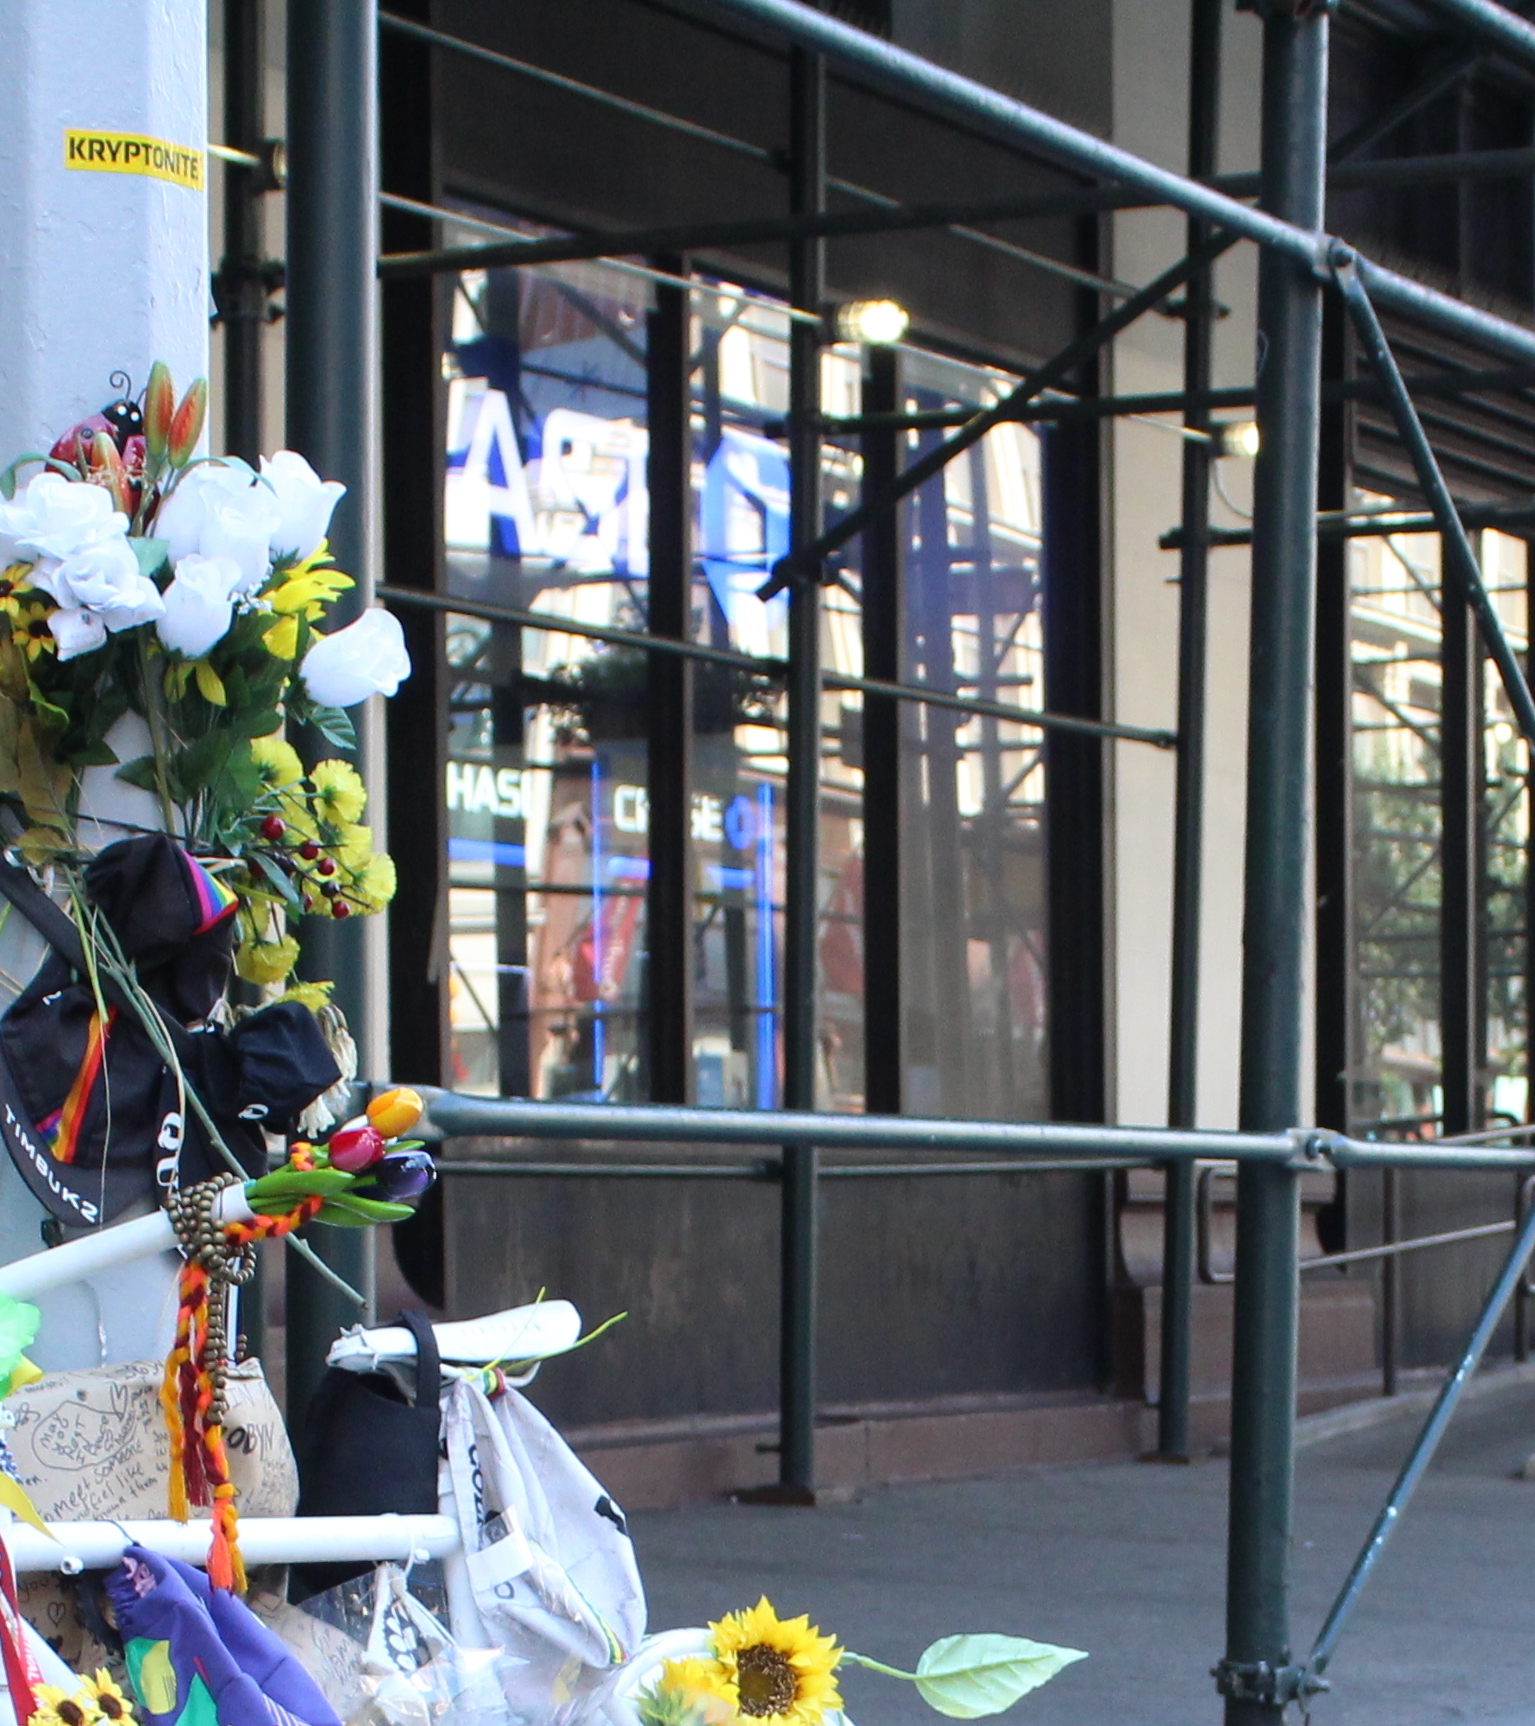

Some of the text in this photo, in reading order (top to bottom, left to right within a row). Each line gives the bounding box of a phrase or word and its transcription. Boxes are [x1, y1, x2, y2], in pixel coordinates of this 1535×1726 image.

[69, 136, 199, 180] KRYPTONITE
[4, 1104, 101, 1224] TIMBUK2
[222, 1422, 274, 1461] OBYN
